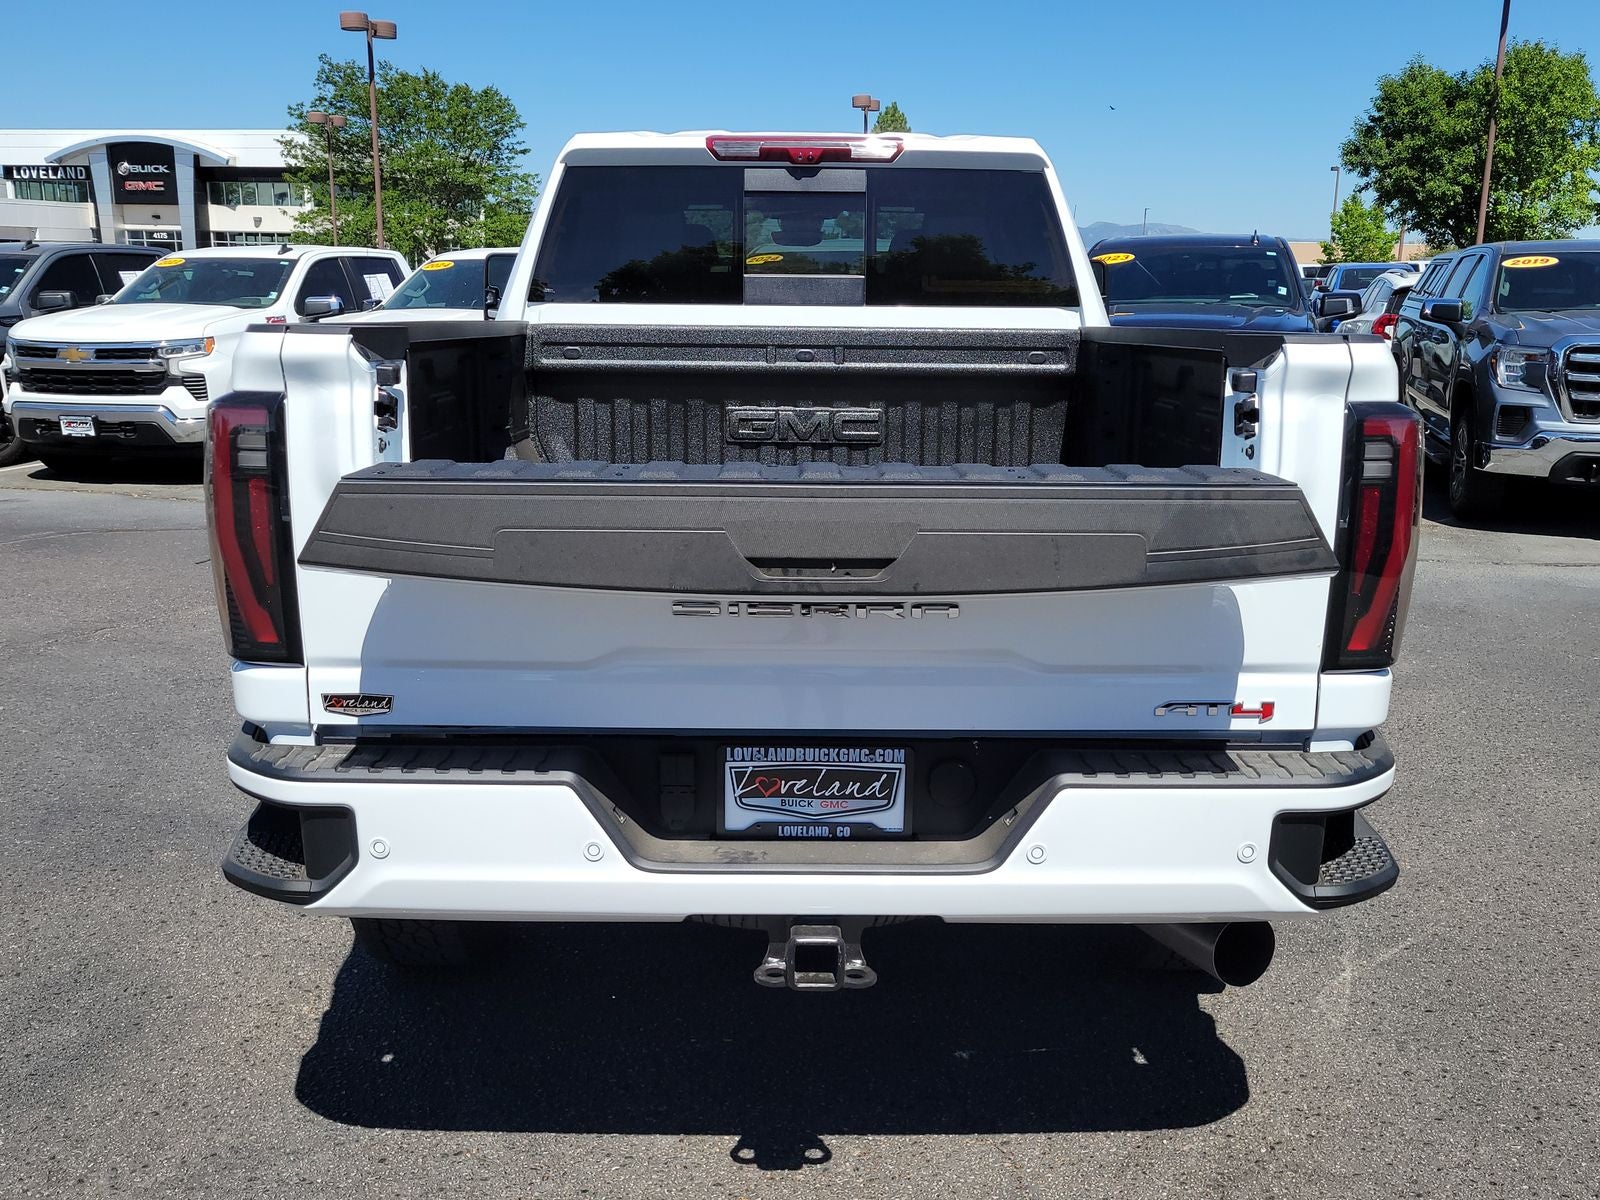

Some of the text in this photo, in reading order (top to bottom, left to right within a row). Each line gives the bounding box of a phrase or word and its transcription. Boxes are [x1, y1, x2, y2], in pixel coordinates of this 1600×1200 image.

[13, 166, 86, 179] LOVELAND
[129, 165, 170, 173] BUICK
[125, 181, 165, 190] GMC
[1510, 258, 1550, 266] 2019
[727, 408, 882, 442] GMC
[672, 600, 960, 618] SIERRA
[1154, 700, 1275, 724] AT4
[726, 747, 905, 763] LOVELANDBUICKGMC.COM
[780, 799, 849, 809] BUICK GMC
[778, 826, 850, 838] LOVELAND, CO
